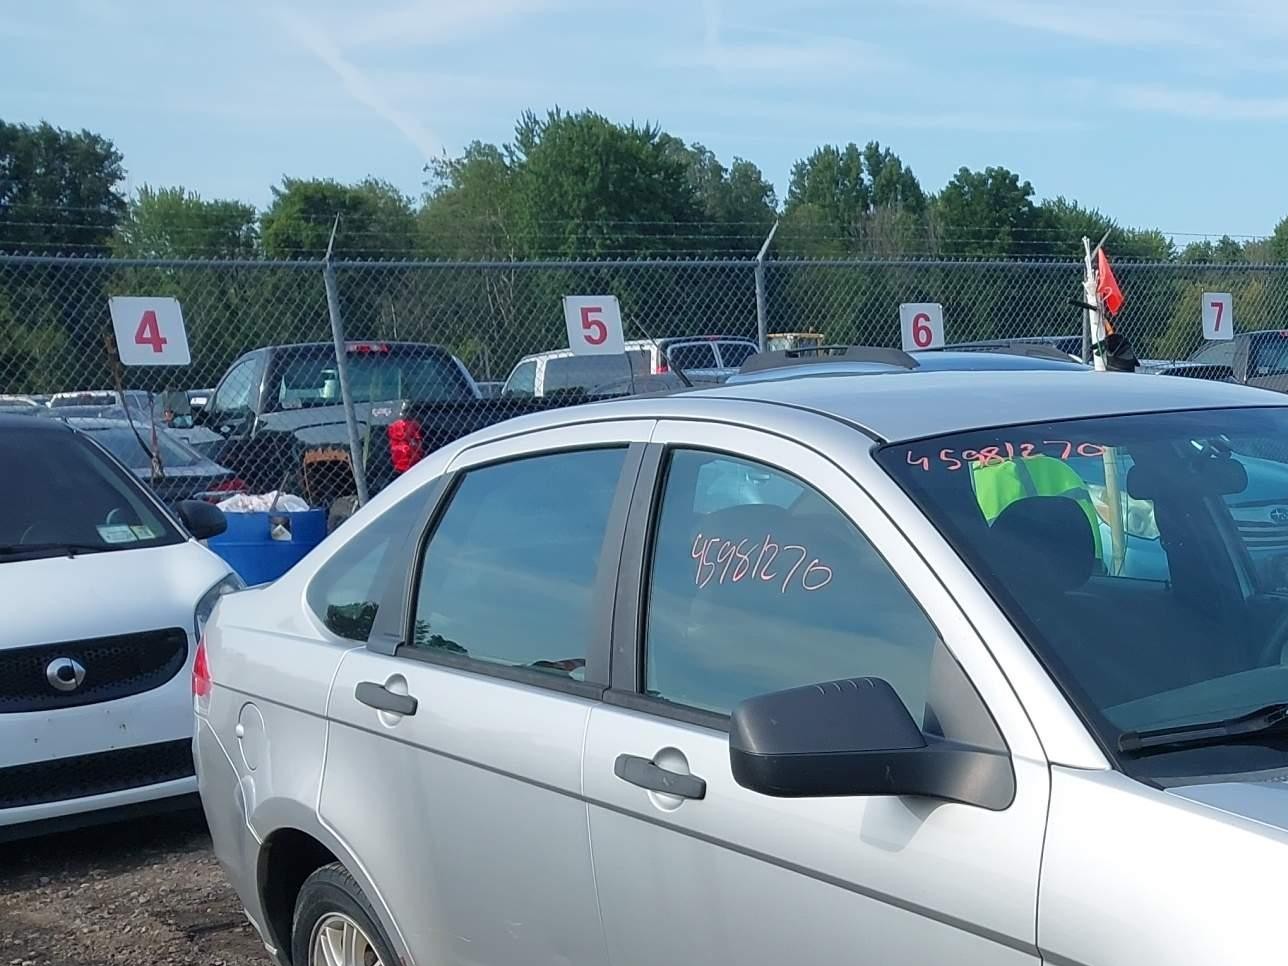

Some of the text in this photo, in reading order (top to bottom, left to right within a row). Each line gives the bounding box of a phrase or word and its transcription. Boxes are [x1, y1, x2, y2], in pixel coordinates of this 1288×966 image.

[135, 310, 167, 352] 4
[581, 307, 608, 345] 5
[913, 313, 932, 348] 6
[1211, 303, 1223, 332] 7
[907, 441, 1105, 471] 45981270
[692, 534, 832, 593] 45981270
